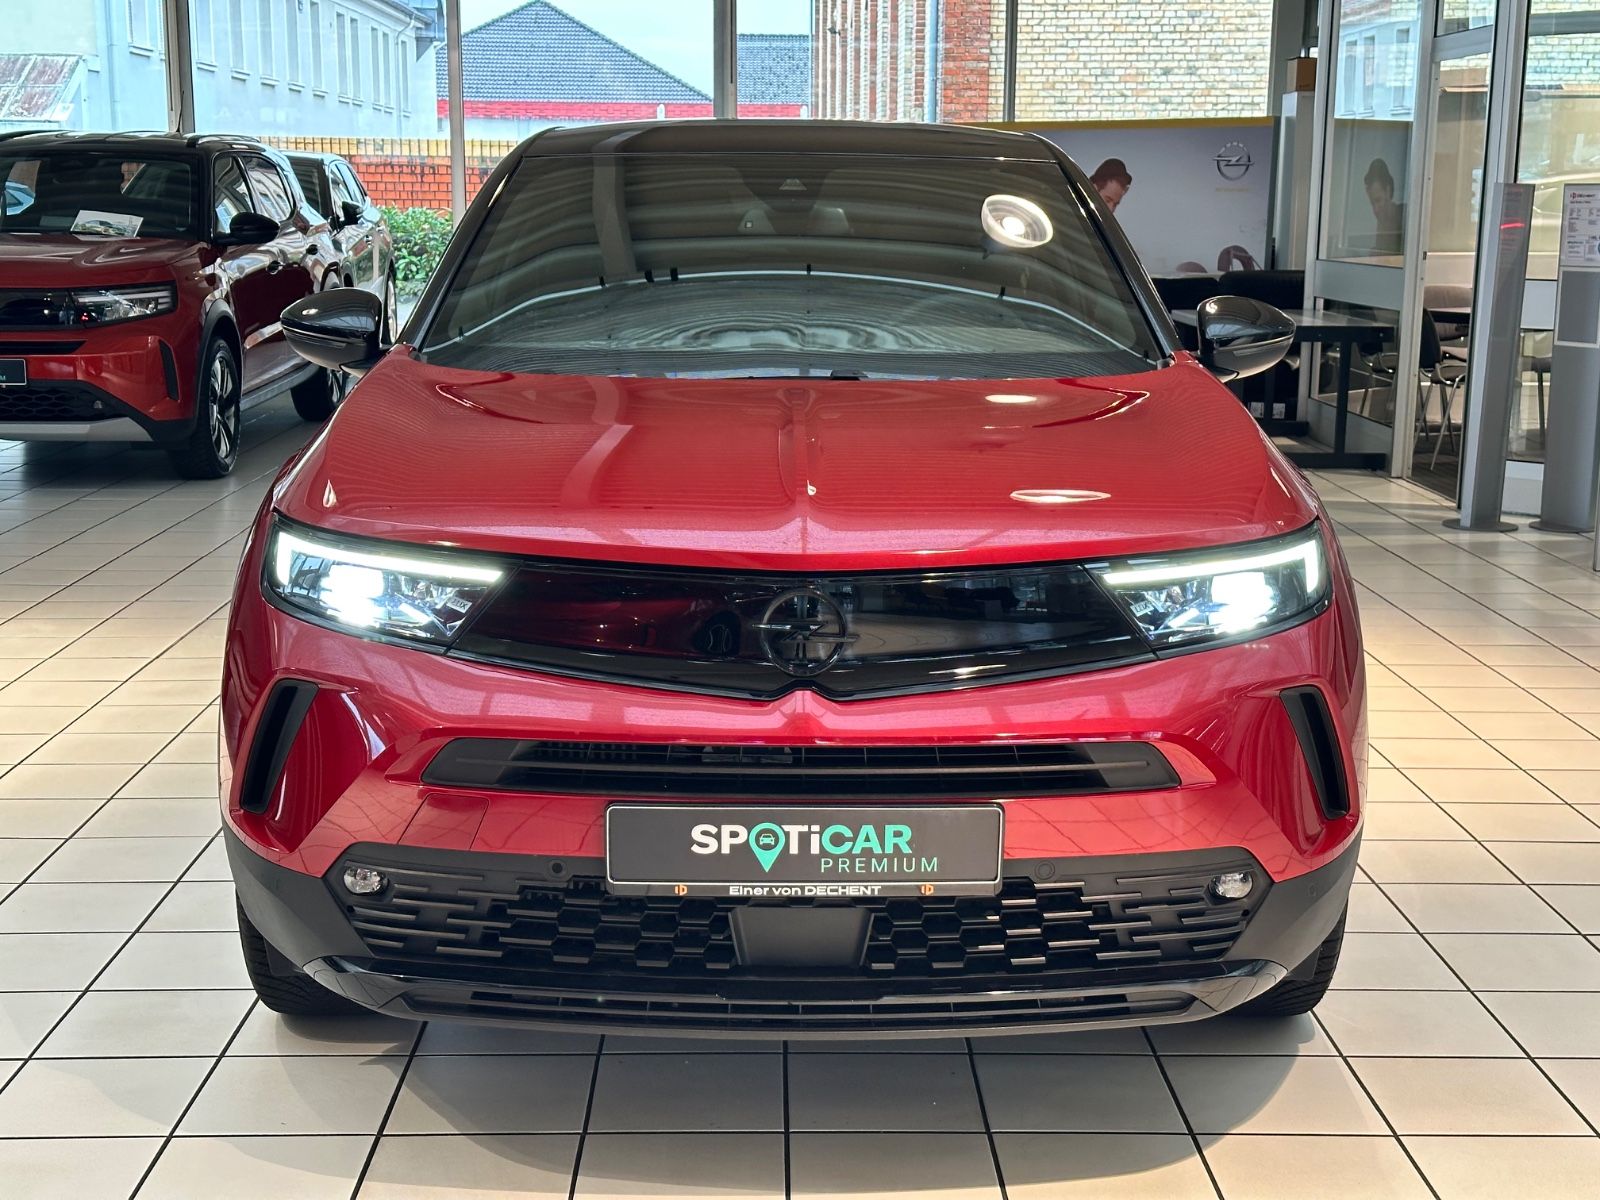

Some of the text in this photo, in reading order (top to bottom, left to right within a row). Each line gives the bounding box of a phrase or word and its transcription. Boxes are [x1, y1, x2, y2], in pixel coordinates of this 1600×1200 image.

[820, 857, 938, 873] PREMIUM
[772, 886, 802, 896] von
[804, 885, 882, 896] DECHENT
